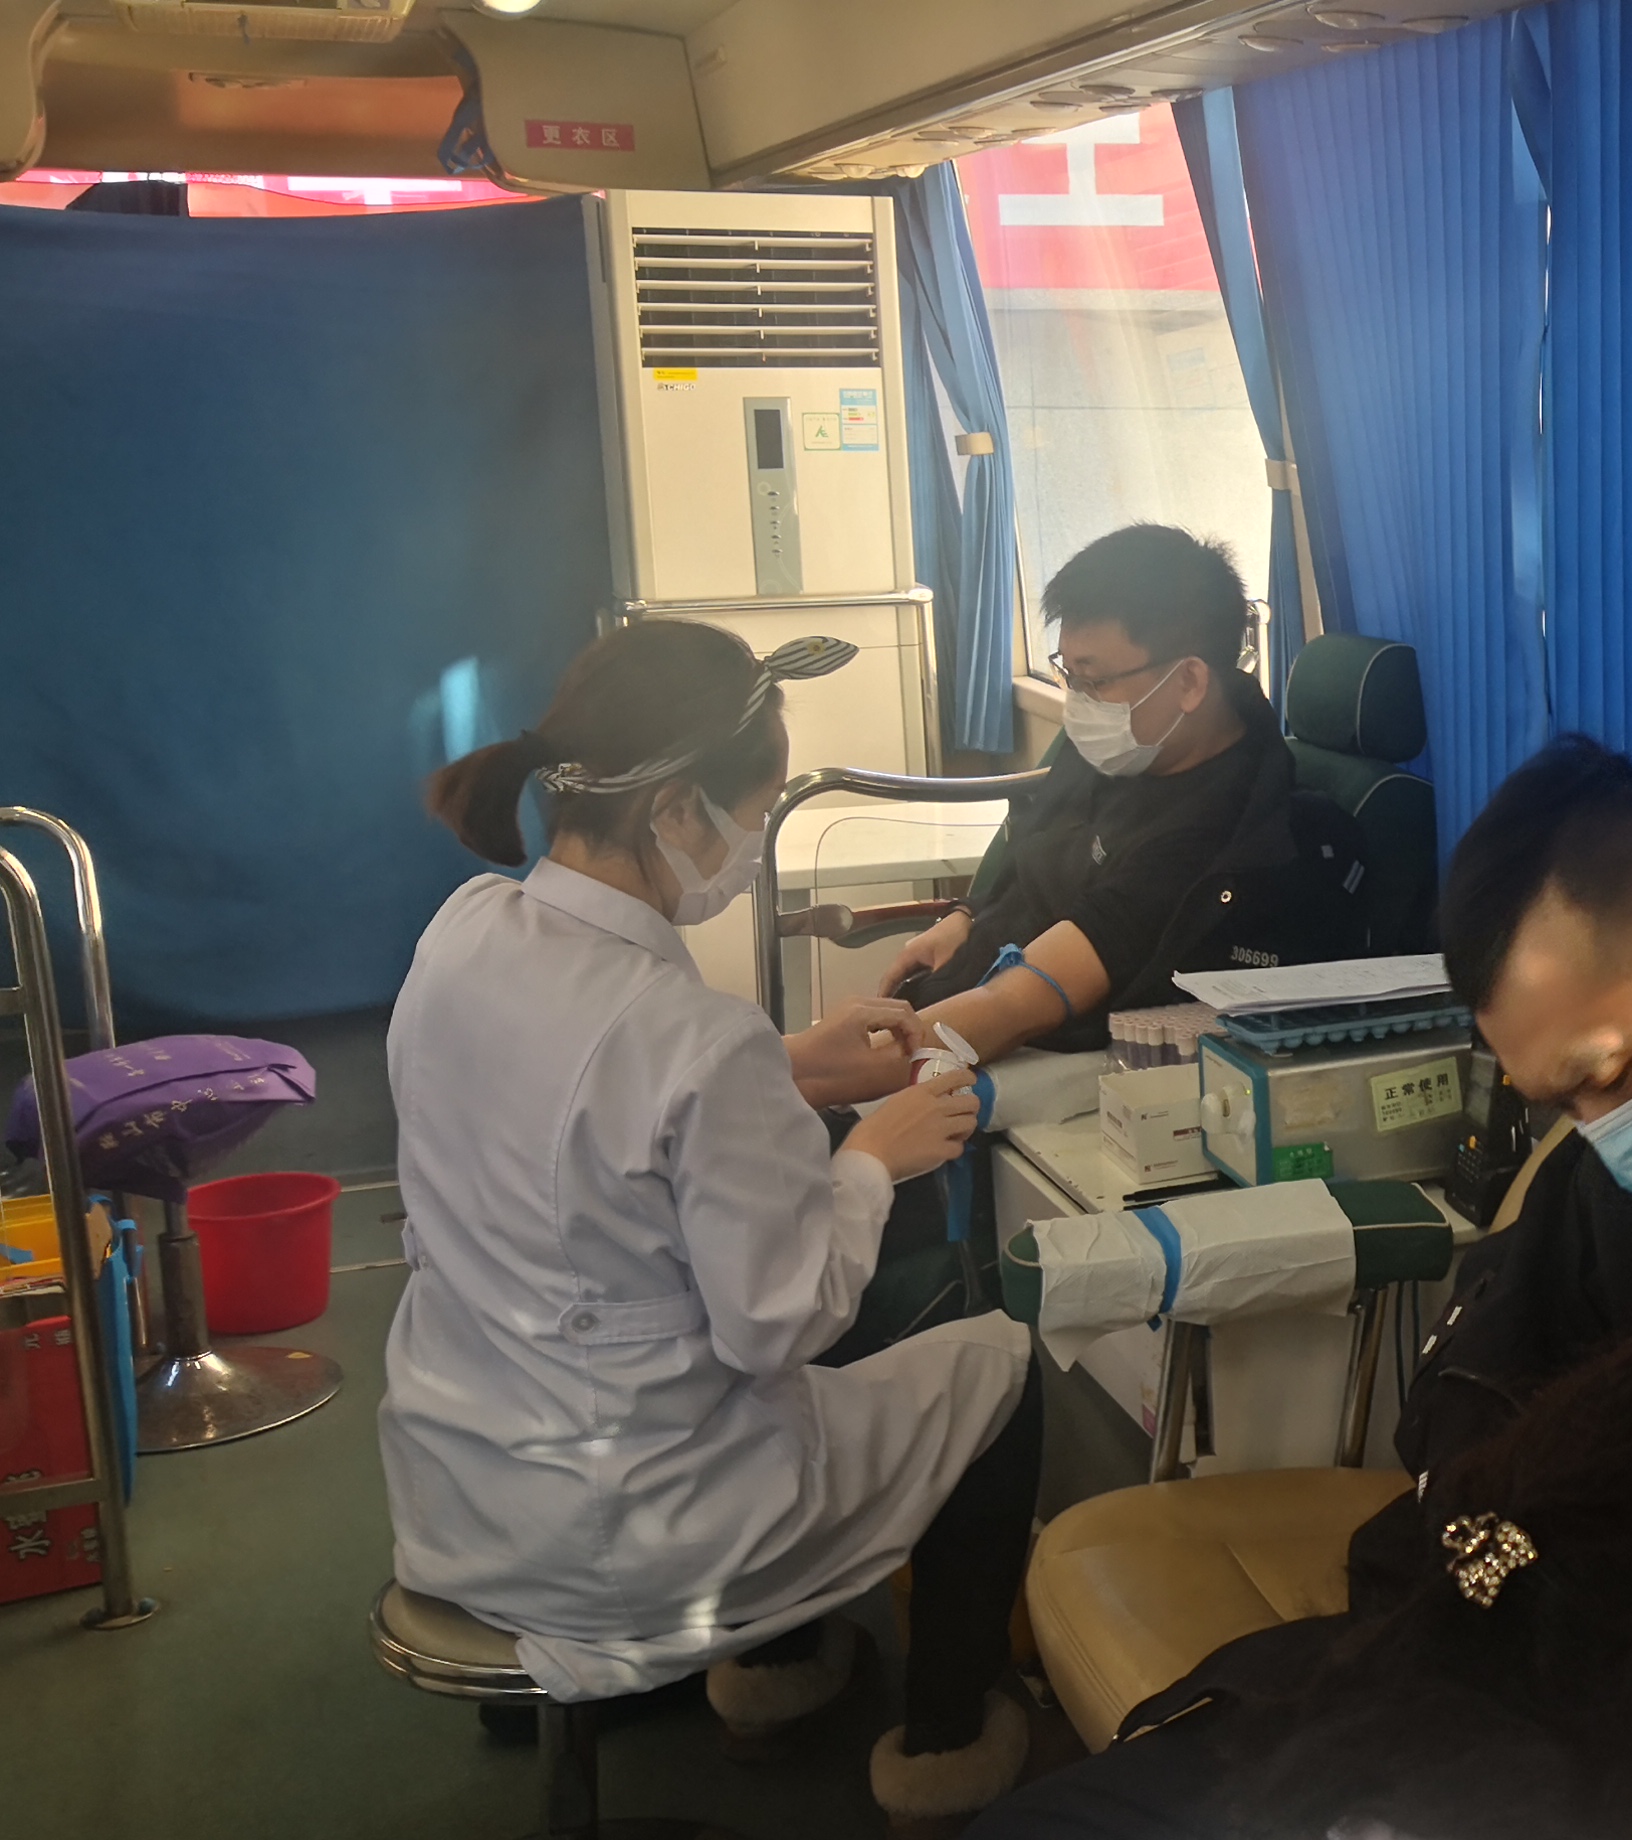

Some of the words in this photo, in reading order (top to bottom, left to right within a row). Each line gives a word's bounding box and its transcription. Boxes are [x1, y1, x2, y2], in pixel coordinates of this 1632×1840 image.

[542, 125, 620, 149] 更衣区
[1231, 945, 1279, 967] 306699
[1384, 1073, 1450, 1100] 正常使用
